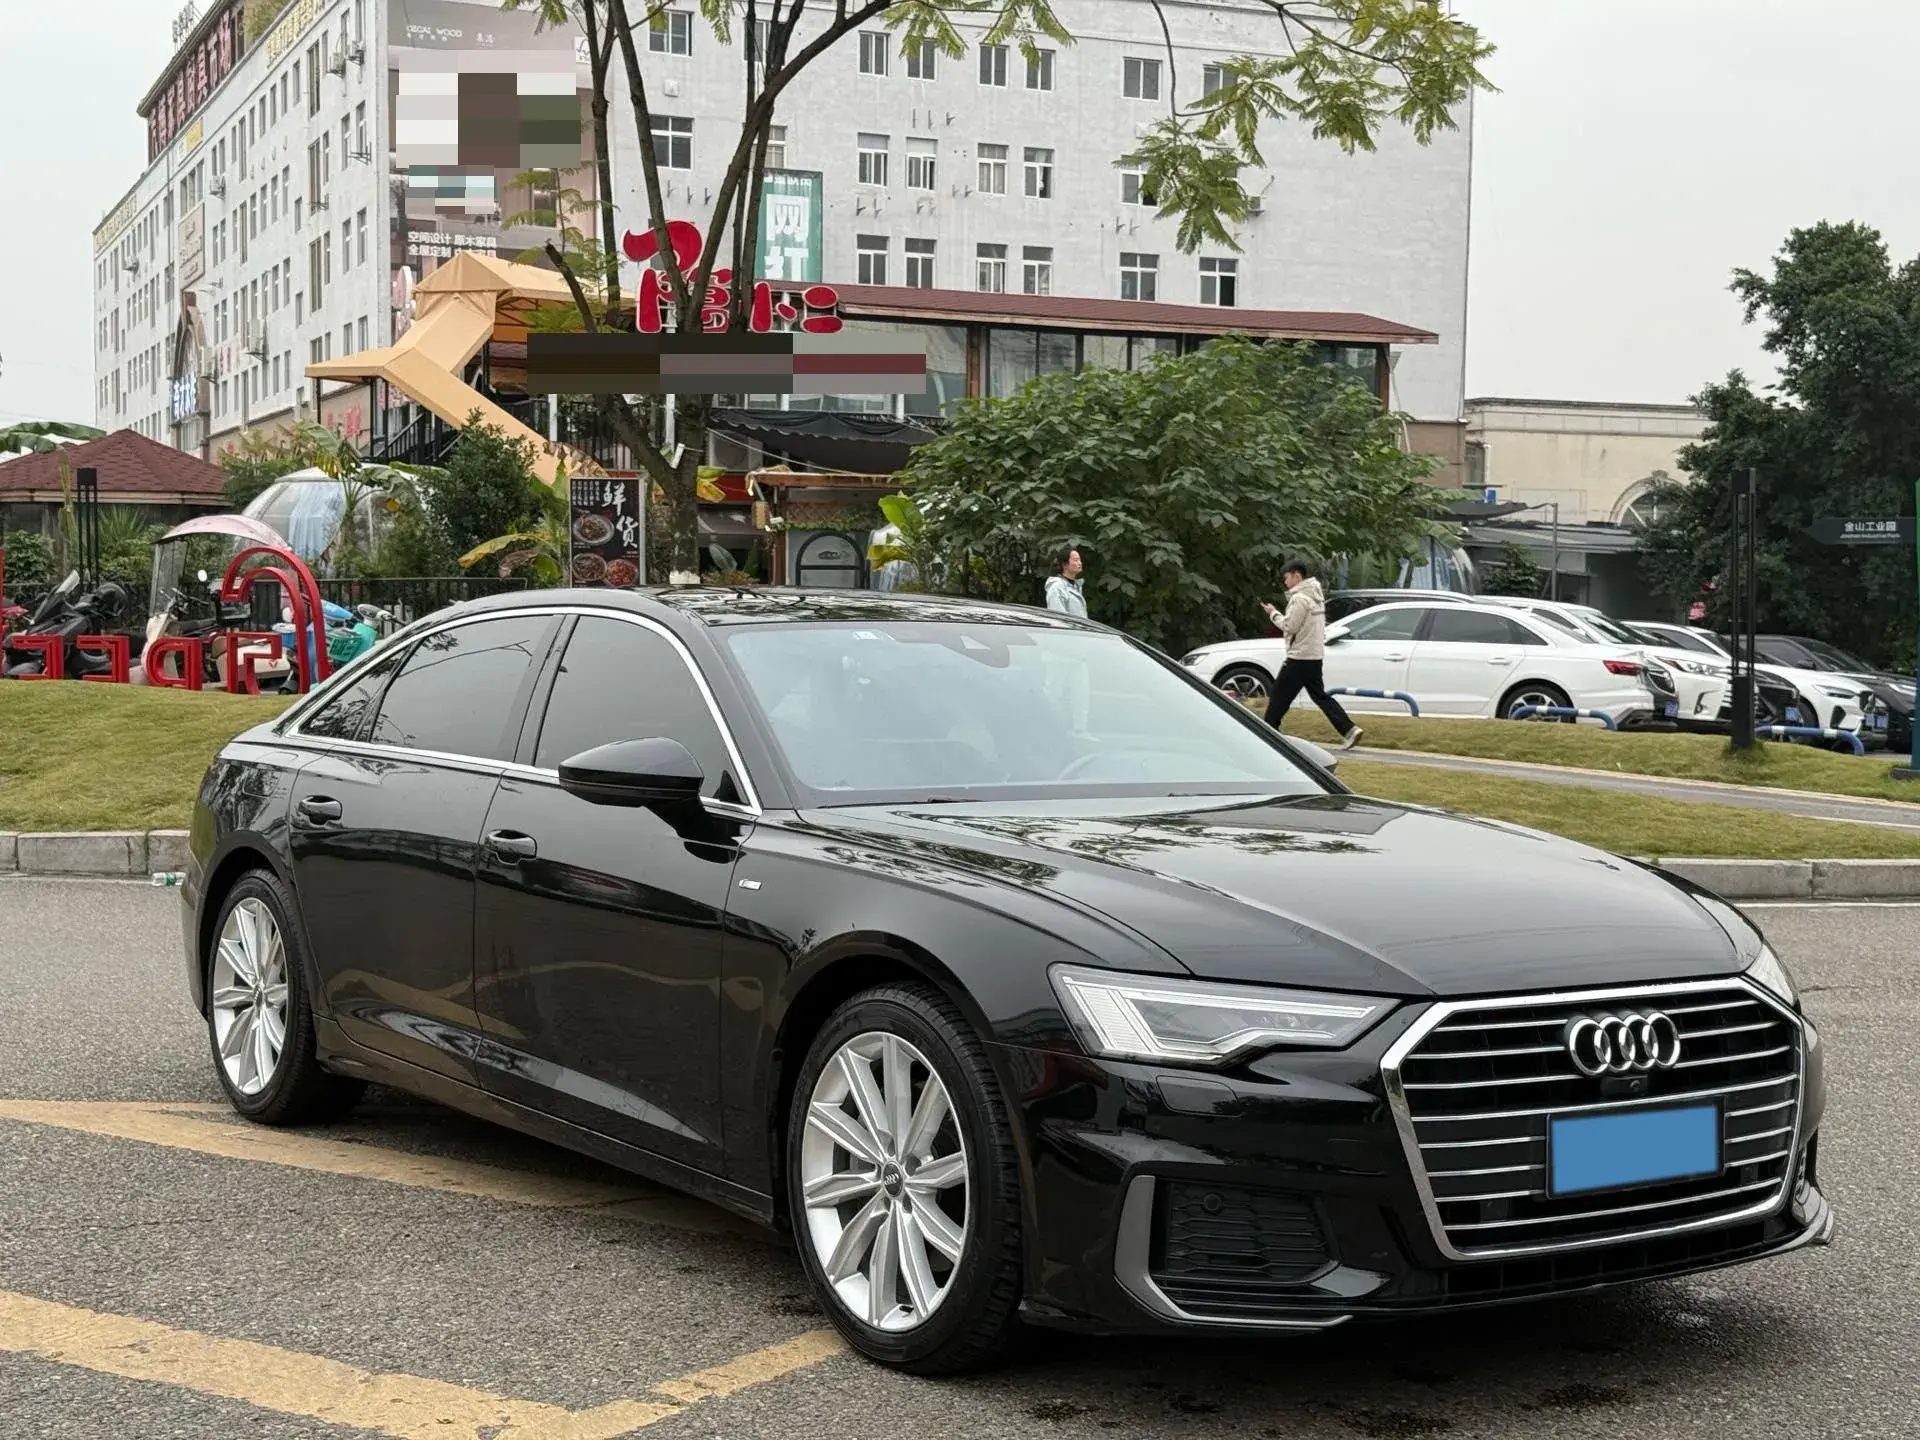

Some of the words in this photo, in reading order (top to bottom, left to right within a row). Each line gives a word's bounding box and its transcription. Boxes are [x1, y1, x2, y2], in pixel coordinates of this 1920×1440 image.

[407, 231, 452, 245] 空间设计
[1844, 520, 1897, 532] 金山工业园
